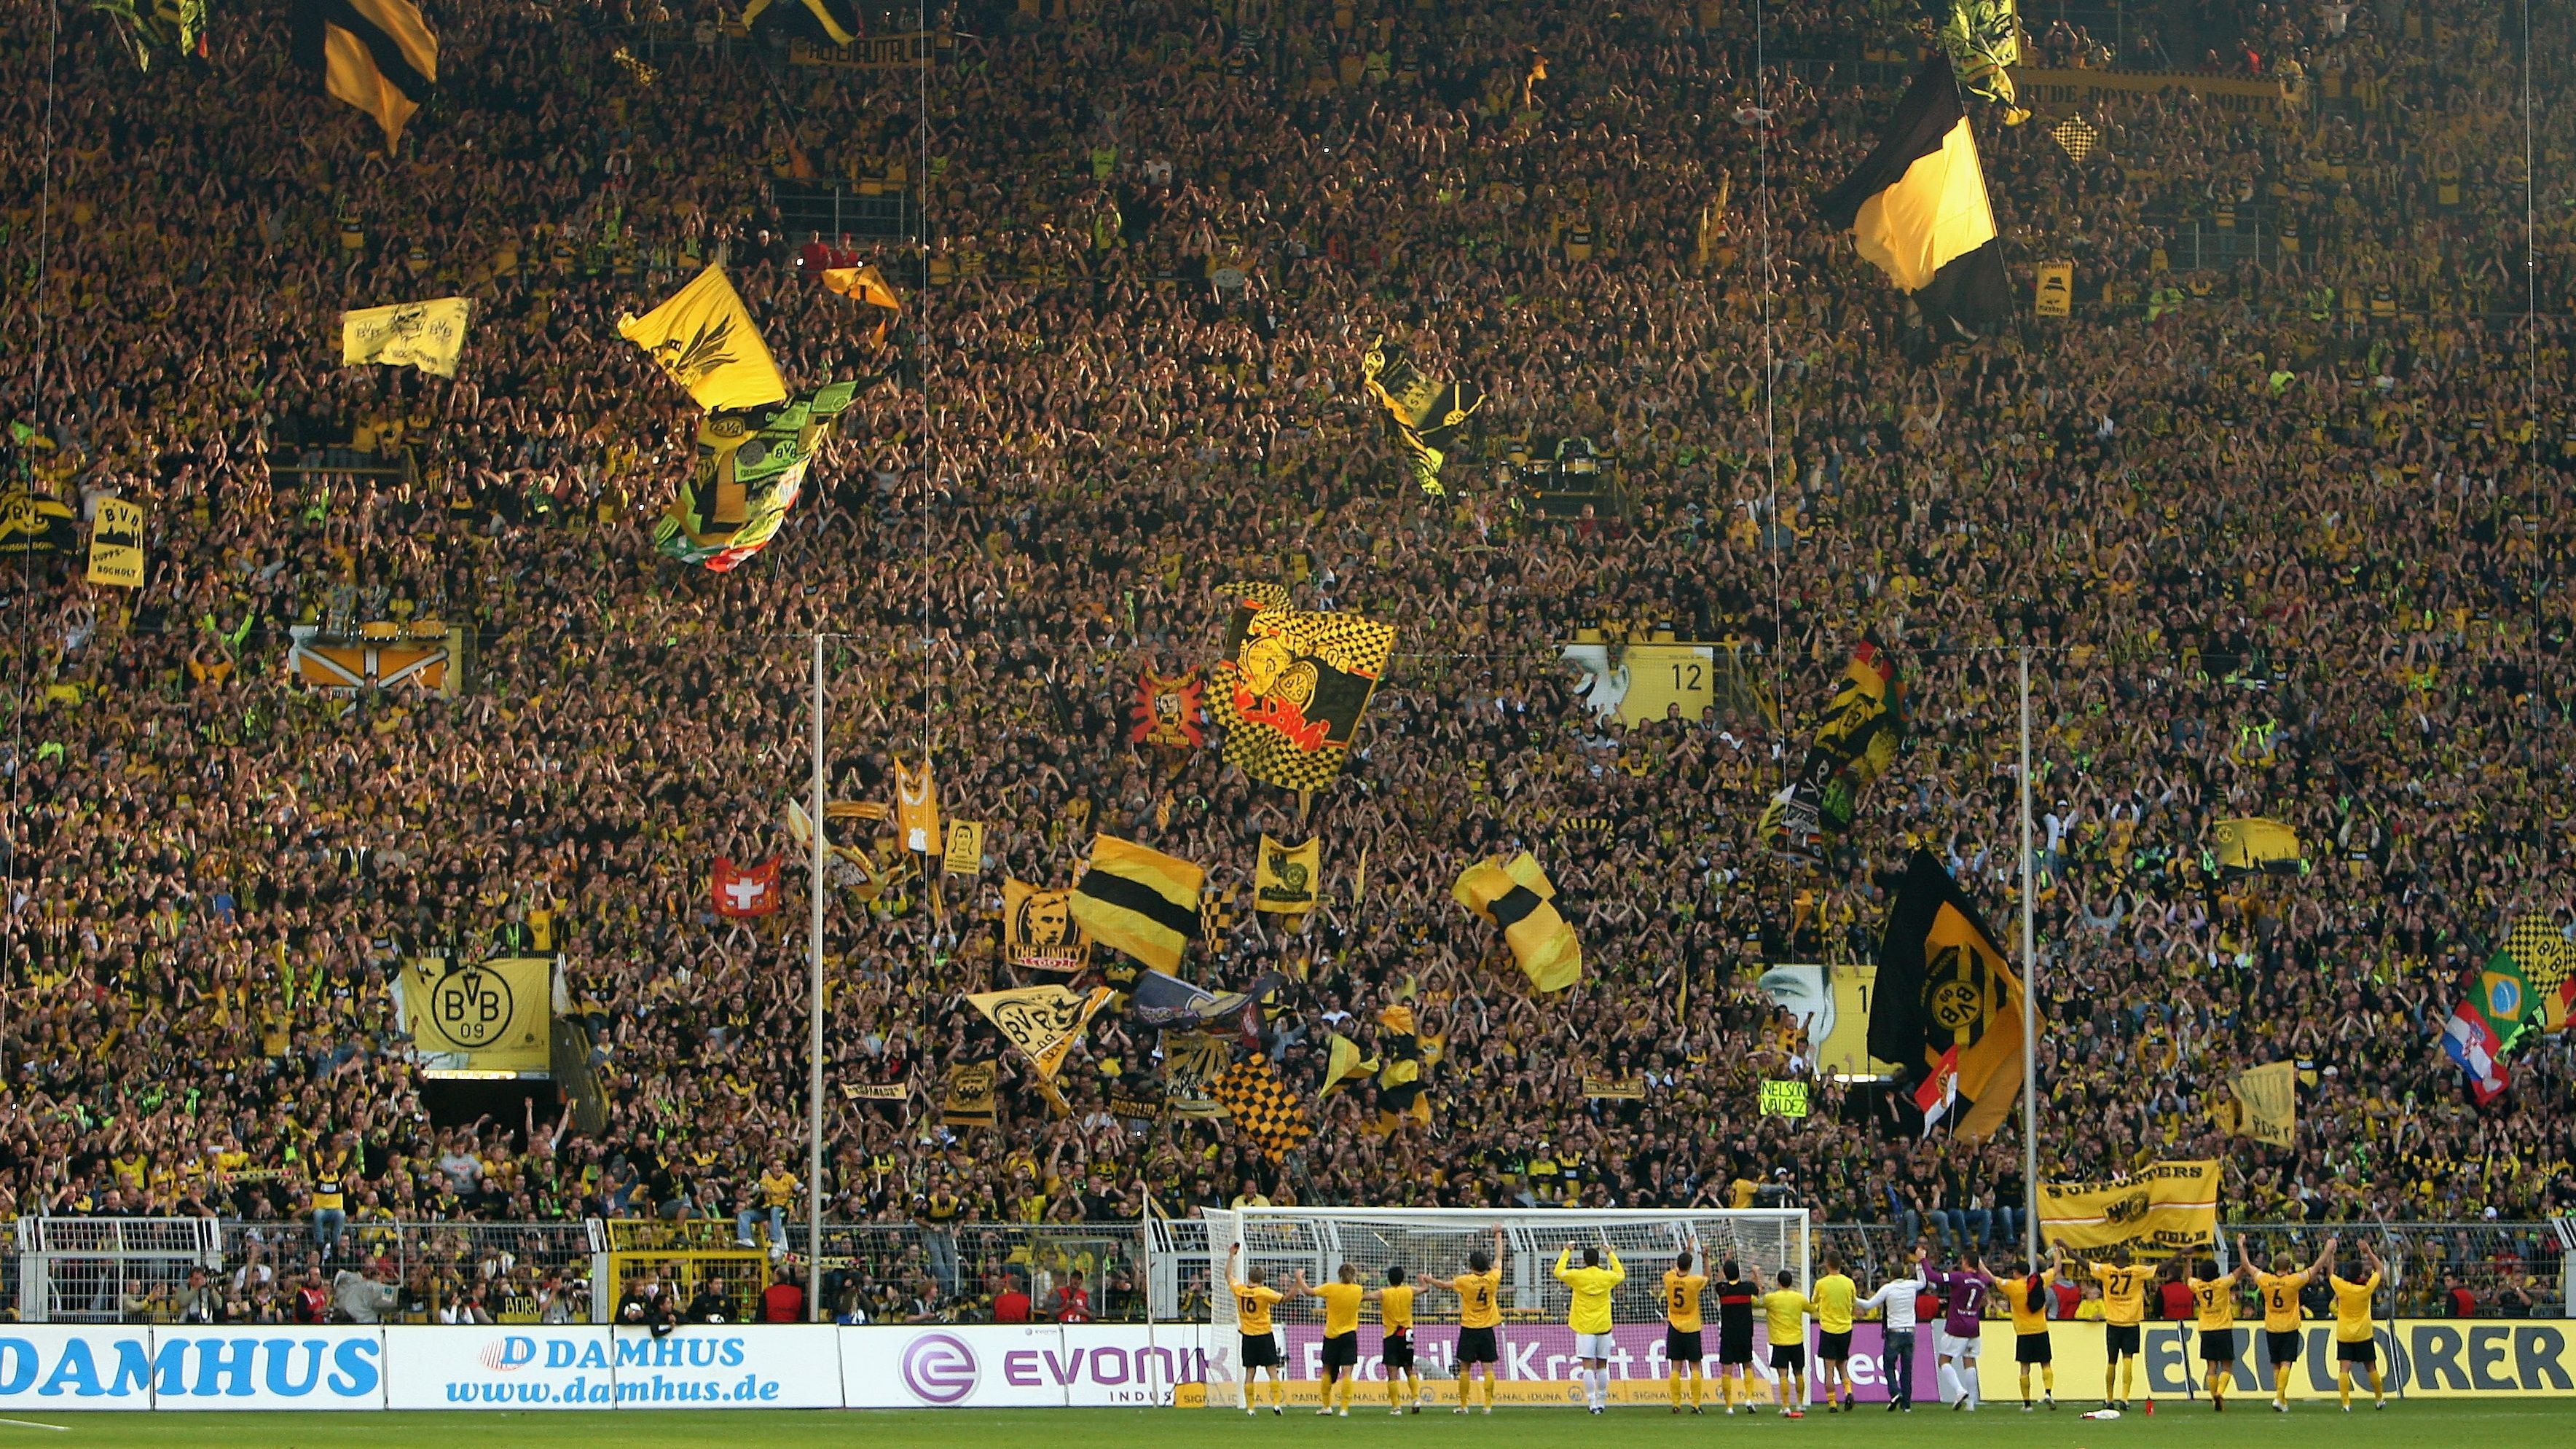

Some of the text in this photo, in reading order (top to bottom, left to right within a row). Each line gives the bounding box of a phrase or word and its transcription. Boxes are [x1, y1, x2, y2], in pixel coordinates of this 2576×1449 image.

[429, 321, 452, 337] BVB
[775, 441, 796, 458] BVB
[105, 507, 139, 527] BVB
[97, 565, 136, 578] BOCHOLT
[1673, 664, 1702, 691] 12
[1015, 945, 1081, 960] THE UNITY
[2537, 940, 2561, 972] BVB
[446, 973, 499, 1021] BVB
[1940, 986, 1977, 1023] BVB
[460, 1024, 484, 1039] 09
[1005, 1008, 1053, 1045] BVB
[1762, 1080, 1807, 1097] NELSON
[1763, 1099, 1805, 1115] VALDEZ
[2046, 1166, 2202, 1198] SUPPORTERS
[2153, 1230, 2207, 1244] GELB
[2110, 1274, 2132, 1295] 27
[1241, 1296, 1257, 1313] 16
[1477, 1287, 1488, 1305] 4
[1673, 1287, 1684, 1308] 5
[1966, 1288, 1976, 1309] 1
[2203, 1289, 2213, 1308] 9
[2273, 1289, 2283, 1308] 6
[544, 1338, 745, 1368] DAMHUS
[1645, 1339, 1720, 1381] fr
[1740, 1343, 1900, 1386] Nues
[0, 1337, 380, 1397] DAMHUS
[1005, 1346, 1233, 1386] EVONIK
[446, 1374, 780, 1403] www.damhus.de
[1292, 1394, 1322, 1402] PARK
[1335, 1393, 1375, 1402] SNAL
[1528, 1393, 1561, 1401] IDUNA
[1634, 1391, 1670, 1399] SIGNAL
